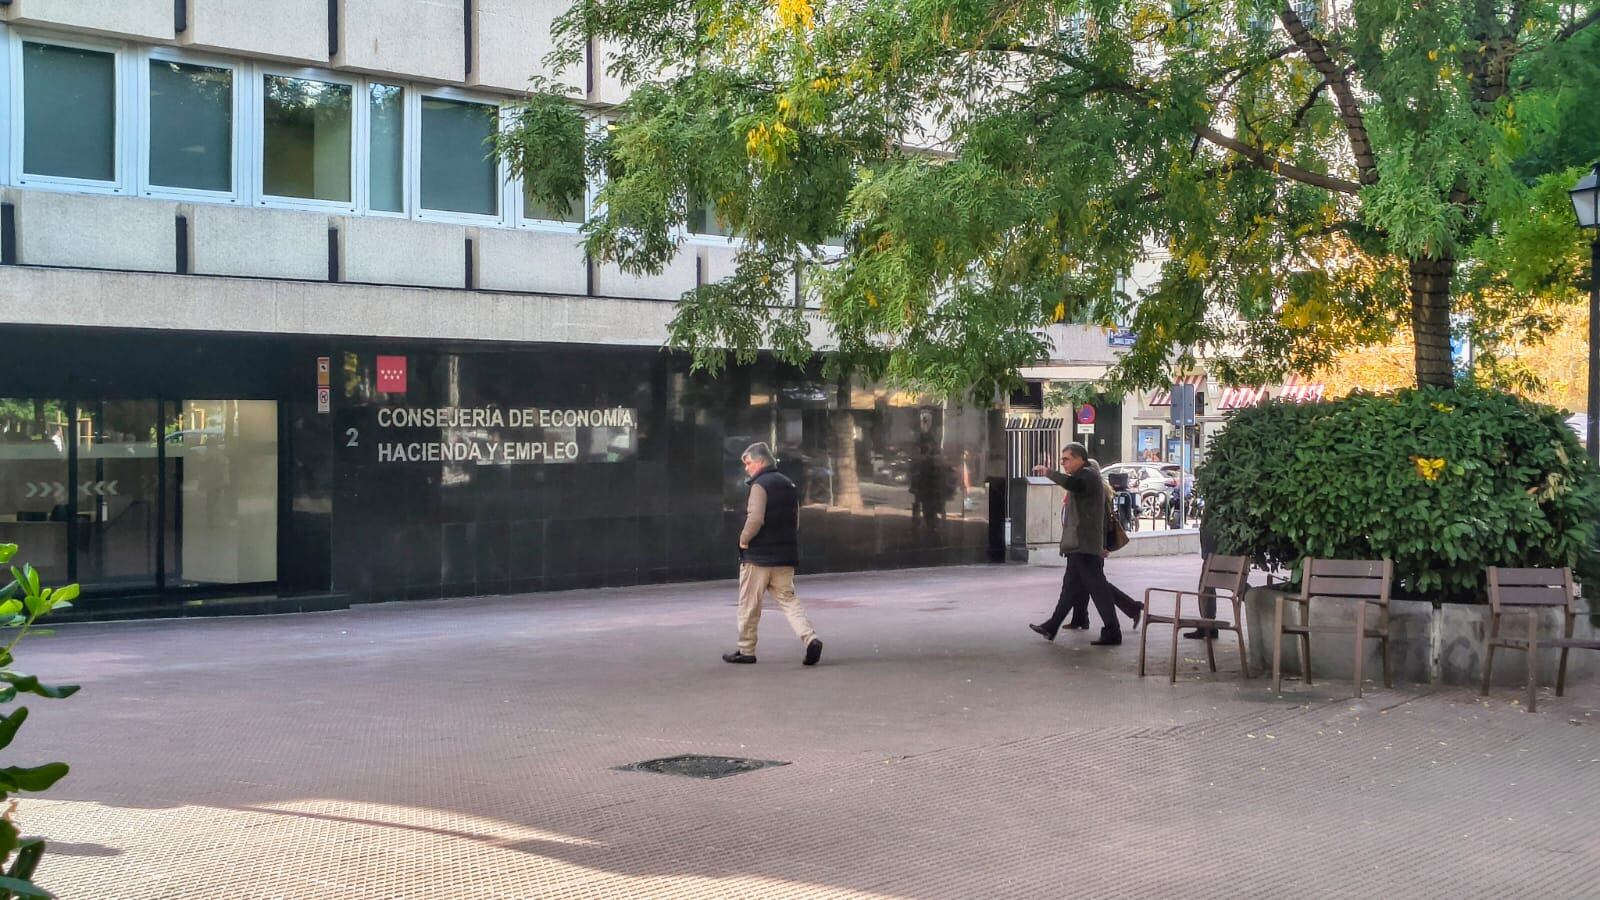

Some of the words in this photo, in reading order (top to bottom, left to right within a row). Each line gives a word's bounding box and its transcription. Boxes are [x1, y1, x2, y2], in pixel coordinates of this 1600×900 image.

[377, 406, 504, 428] CONSEJERÍA
[508, 408, 533, 427] DE
[540, 405, 637, 429] ECONOMÍA,
[346, 427, 359, 447] 2
[377, 442, 482, 463] HACIENDA
[487, 442, 499, 461] Y
[503, 442, 579, 461] EMPLEO
